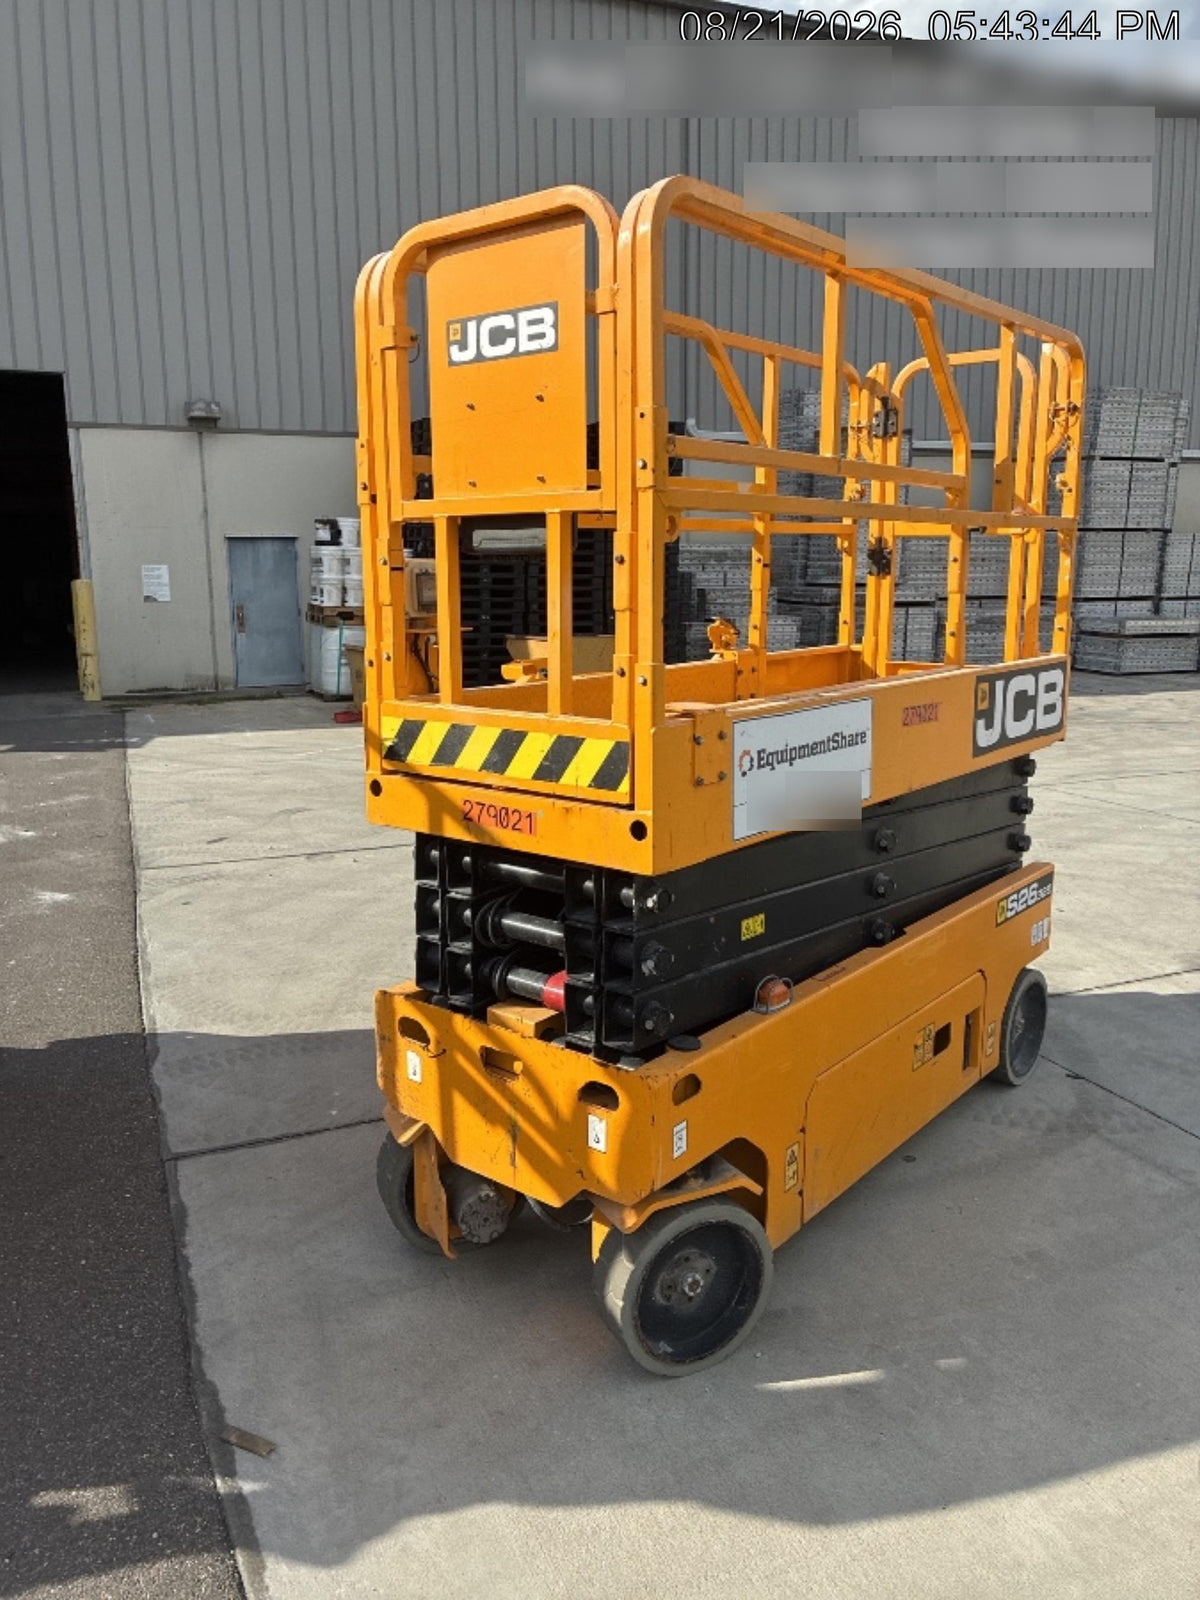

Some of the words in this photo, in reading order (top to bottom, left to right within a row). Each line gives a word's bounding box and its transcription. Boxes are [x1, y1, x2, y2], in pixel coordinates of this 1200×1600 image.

[449, 306, 556, 363] JCB
[976, 668, 1064, 748] JCB
[756, 730, 867, 771] EquipmentShare
[462, 799, 533, 835] 279021
